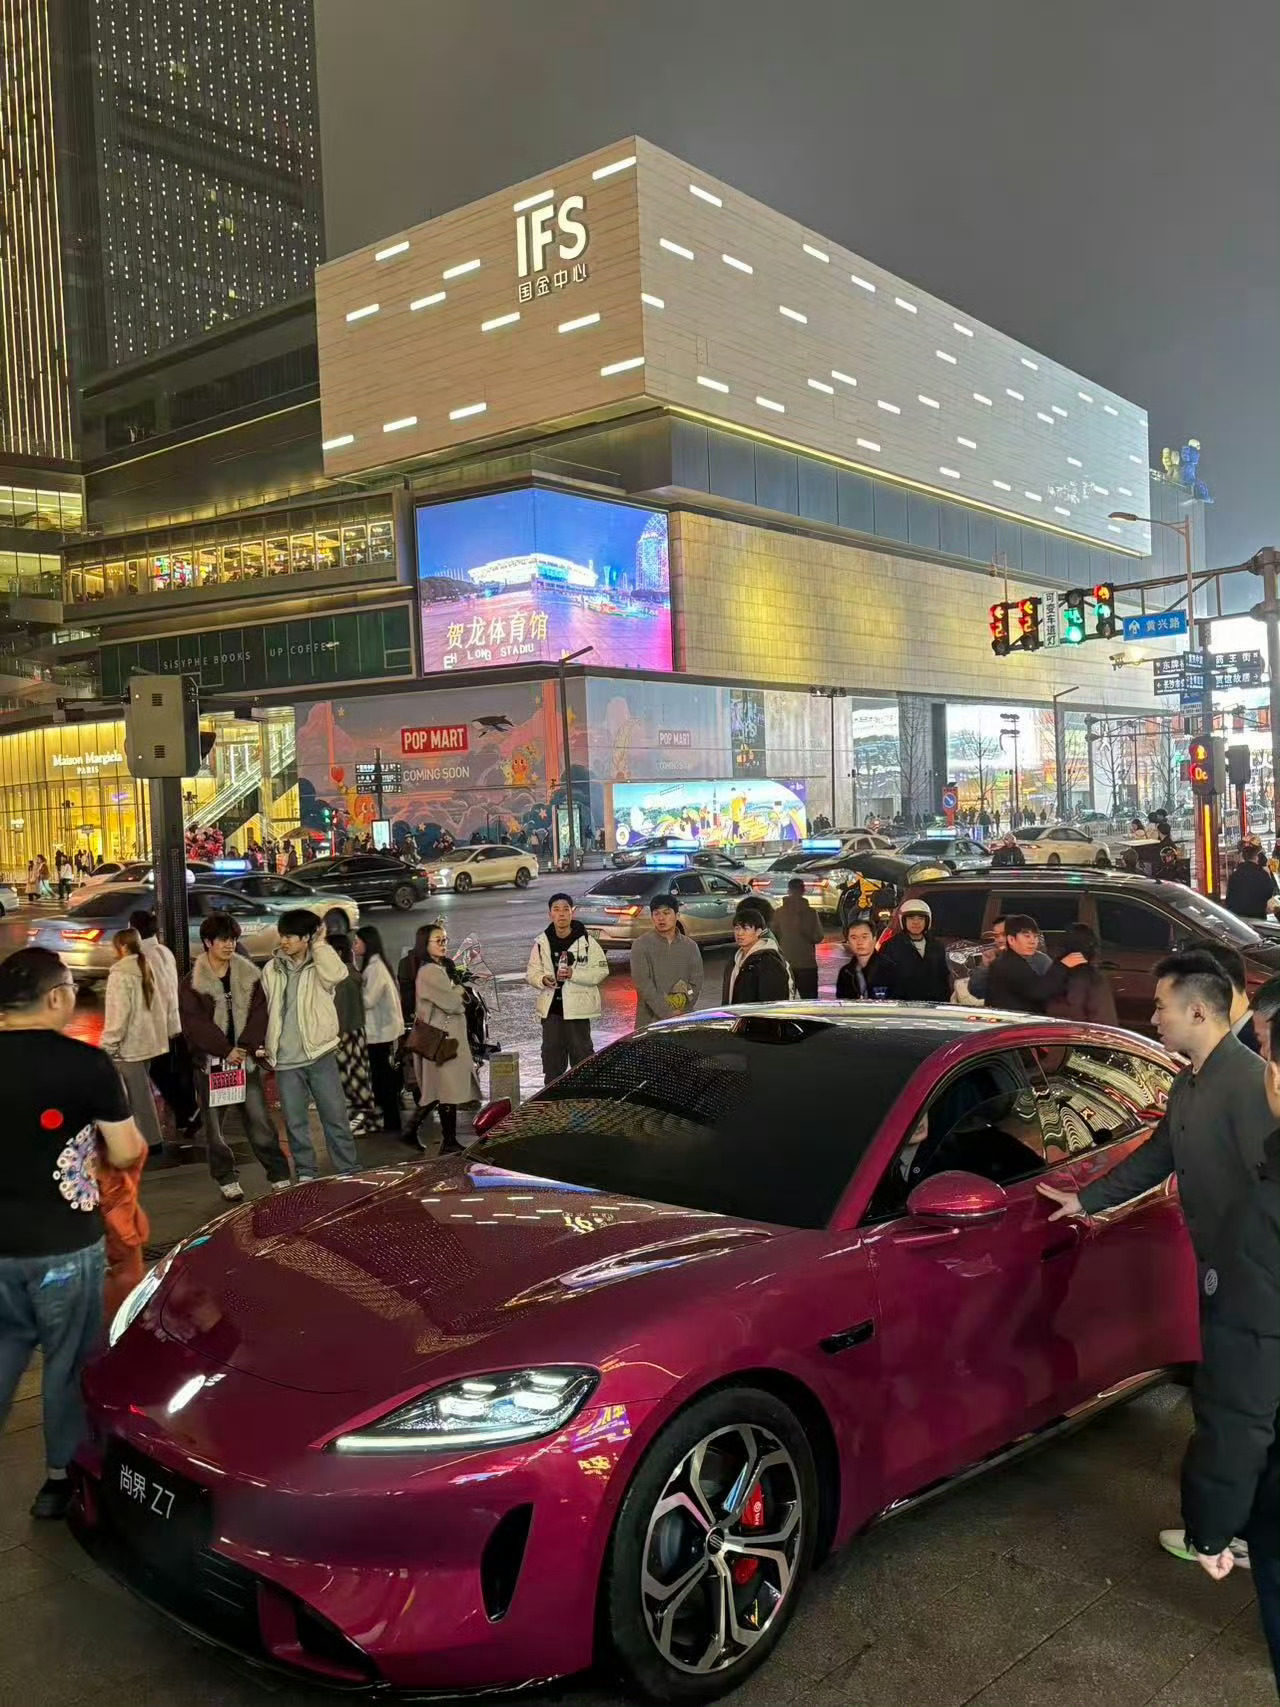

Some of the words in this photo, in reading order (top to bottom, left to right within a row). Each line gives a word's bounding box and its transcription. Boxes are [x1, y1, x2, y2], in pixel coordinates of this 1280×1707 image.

[516, 195, 587, 278] IFS
[518, 263, 587, 304] 国金中心
[447, 610, 549, 650] 贺龙体育馆
[1146, 616, 1180, 632] 黄兴路
[214, 651, 251, 664] BOOKS
[269, 647, 284, 657] UP
[404, 731, 427, 751] POP
[430, 728, 464, 749] MART
[52, 754, 84, 767] Maison
[77, 765, 99, 775] PARIS
[403, 768, 440, 782] COMING
[442, 766, 470, 780] SOON
[120, 1463, 146, 1504] 尚界
[151, 1482, 176, 1519] Z7
